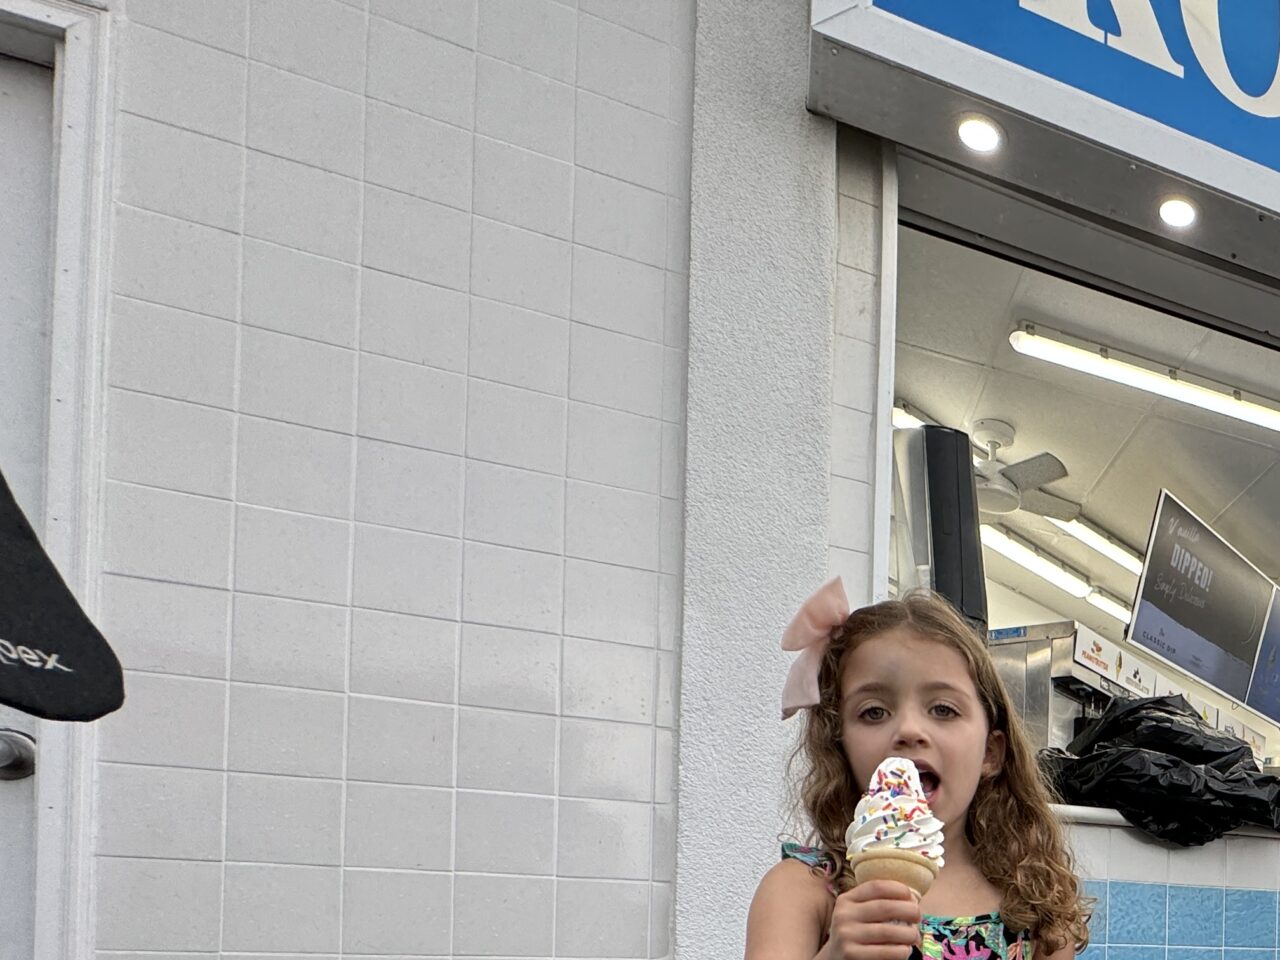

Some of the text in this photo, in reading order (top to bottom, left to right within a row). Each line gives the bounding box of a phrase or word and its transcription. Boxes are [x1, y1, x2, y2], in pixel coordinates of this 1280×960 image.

[1170, 543, 1213, 592] DIPPED!
[1142, 631, 1166, 649] CLASSIC
[1166, 645, 1176, 655] DIP
